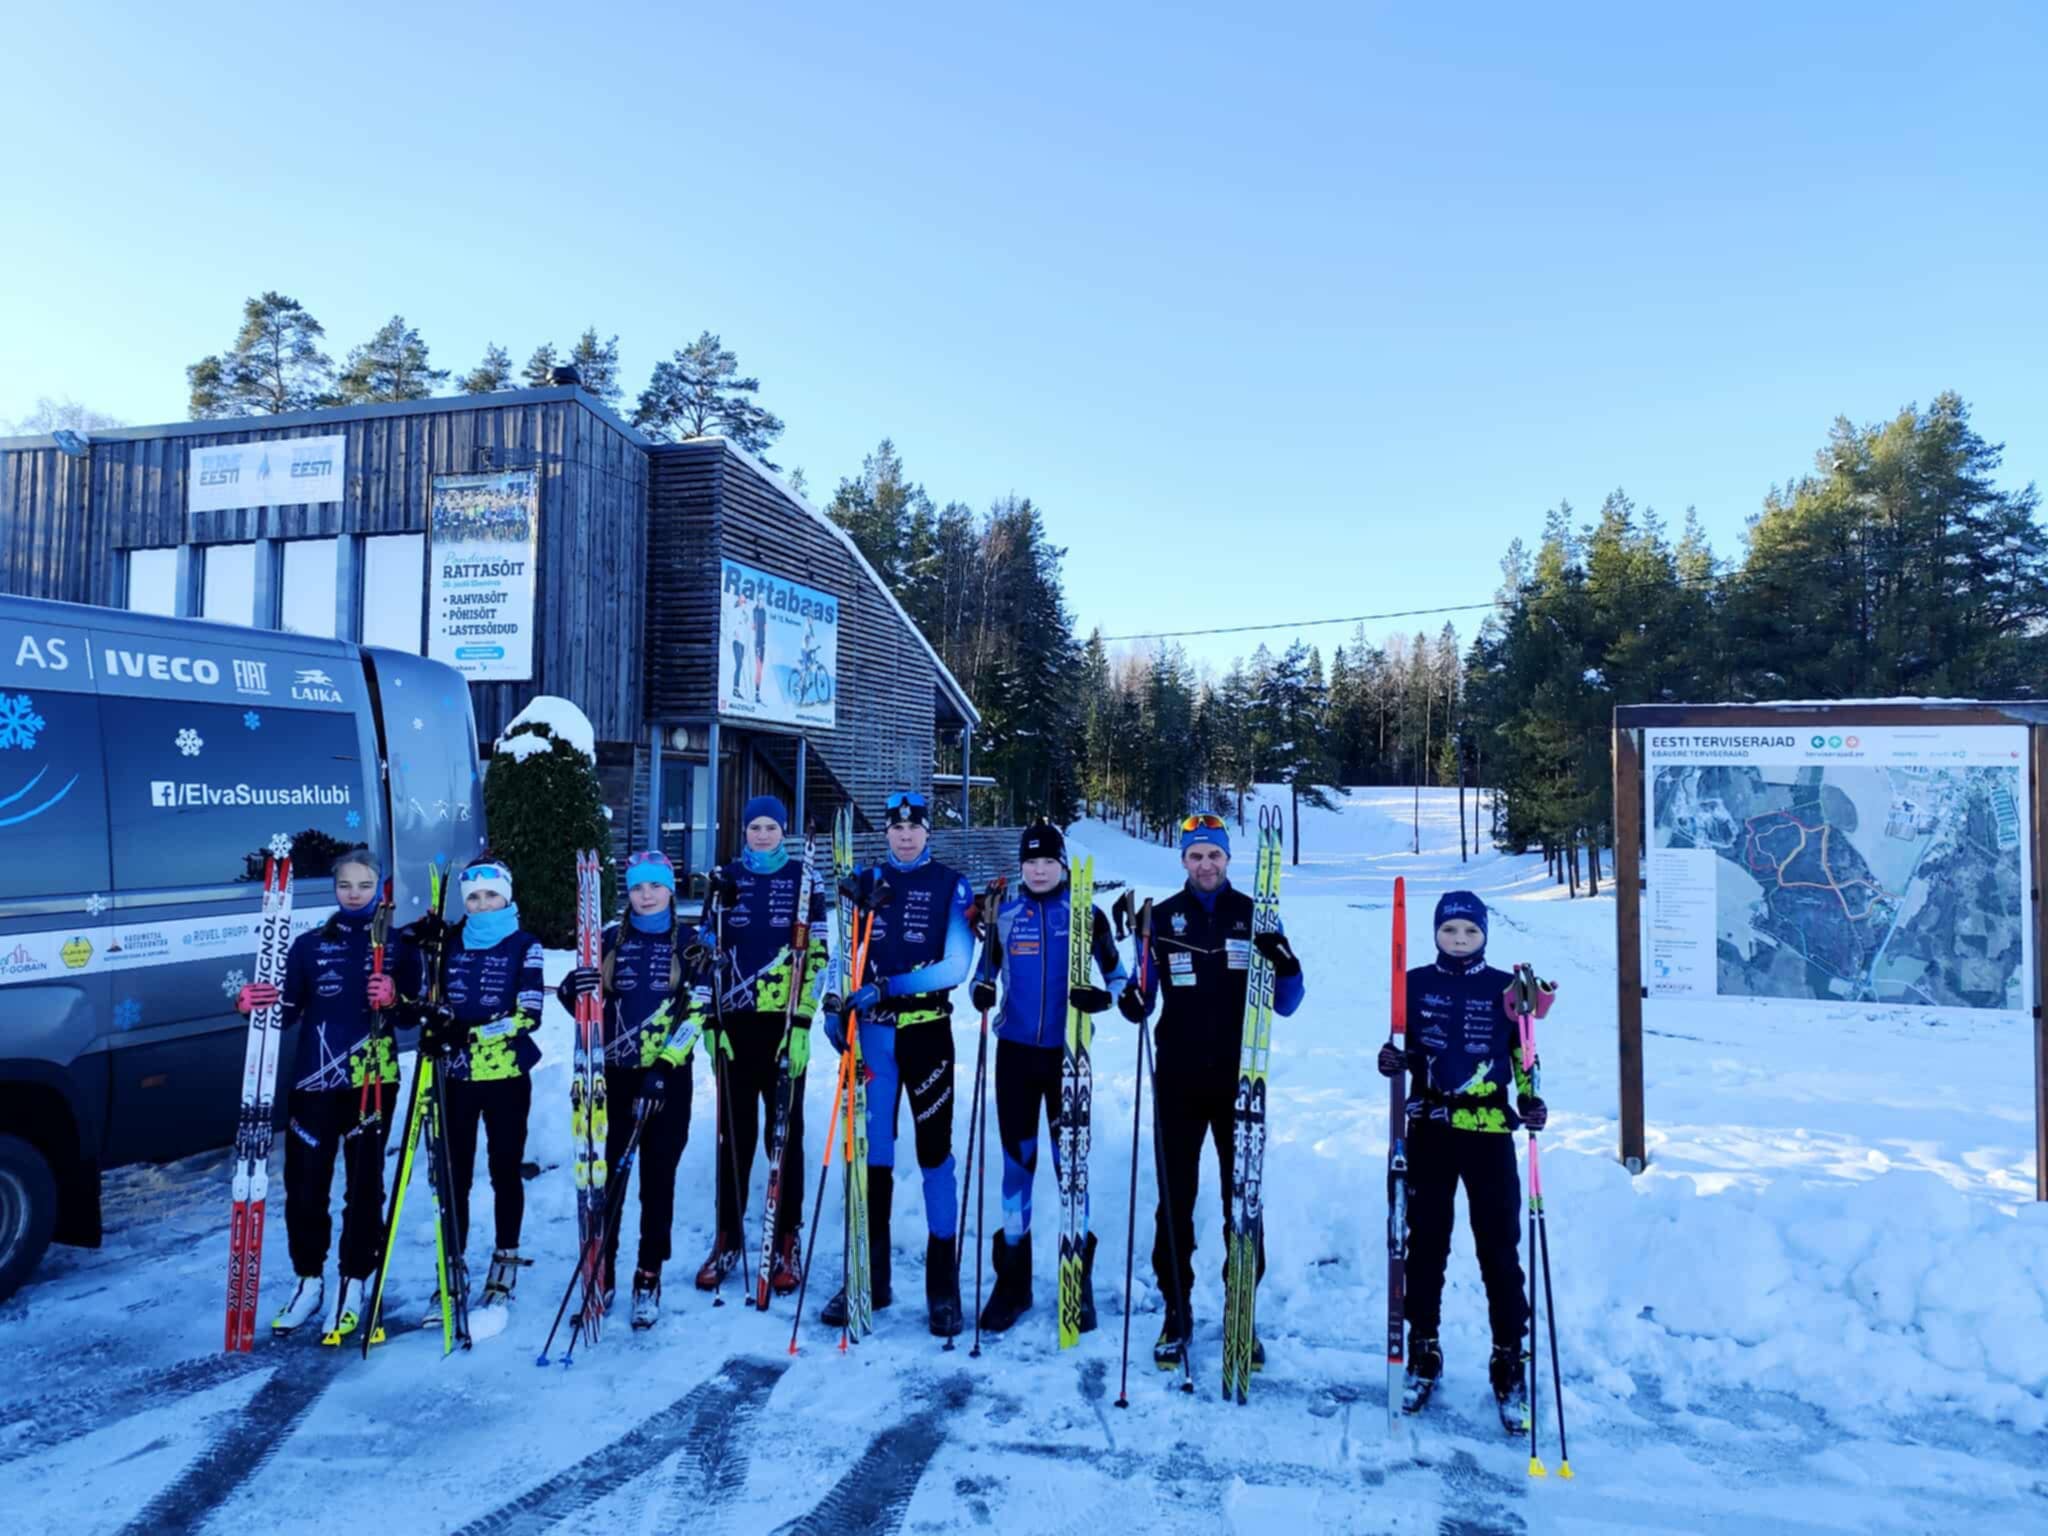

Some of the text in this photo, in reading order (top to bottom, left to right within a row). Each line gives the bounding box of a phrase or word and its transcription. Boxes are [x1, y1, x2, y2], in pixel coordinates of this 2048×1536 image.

[291, 460, 332, 478] EESTI
[443, 560, 525, 579] RATTASÕIT
[449, 590, 508, 605] RAHVASÕIT
[723, 565, 835, 625] Rattabaas
[448, 621, 518, 635] LASTESÕIDUD
[449, 606, 497, 620] PÕHISÕIT
[15, 636, 69, 671] AS
[104, 649, 220, 685] IVECO
[232, 659, 268, 690] FIAT
[290, 686, 343, 704] LAIKA
[1652, 736, 1796, 748] EESTI TERVISERAJAD
[841, 895, 854, 977] FISCHE
[1071, 906, 1082, 986] FISCHER
[253, 915, 276, 1031] ROSIGNOL
[760, 1199, 776, 1284] ATOMIC
